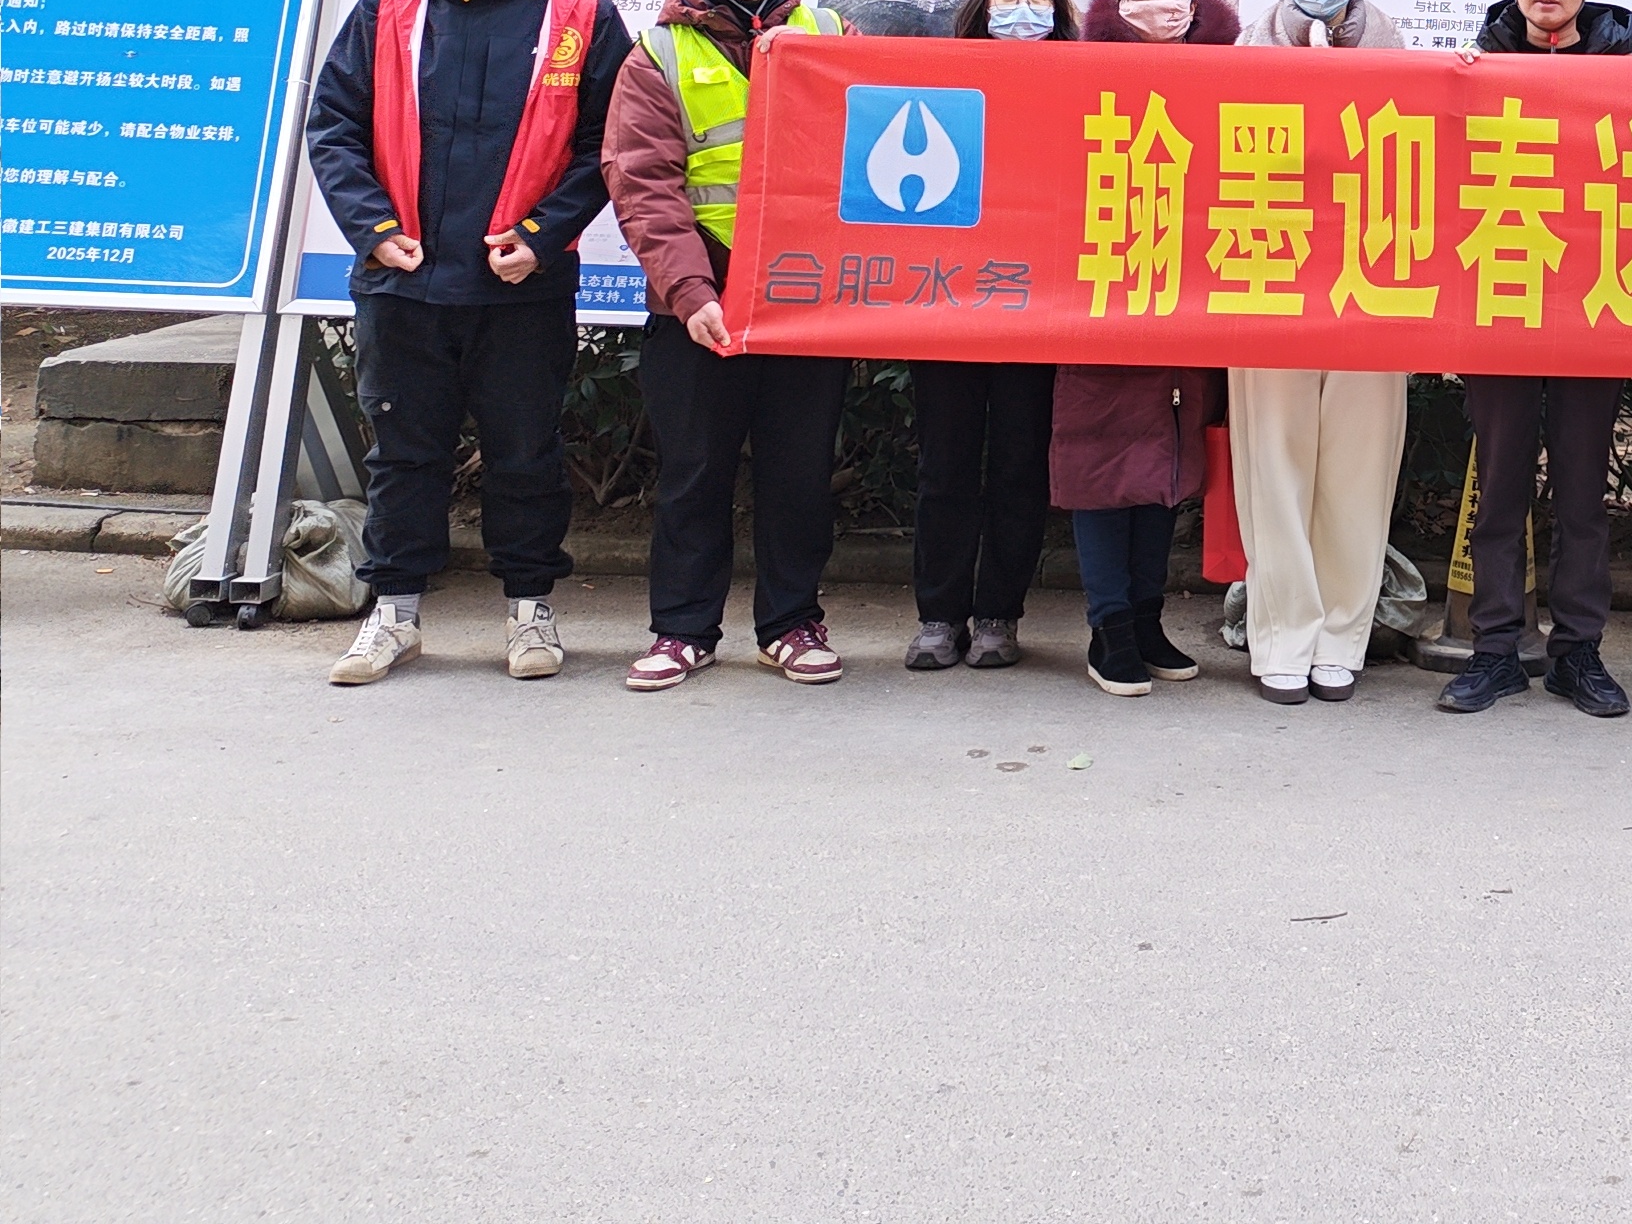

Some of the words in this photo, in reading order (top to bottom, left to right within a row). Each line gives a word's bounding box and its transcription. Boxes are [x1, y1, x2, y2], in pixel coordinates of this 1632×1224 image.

[0, 19, 250, 43] 入内，路过时请保持安全距离，照
[0, 118, 242, 142] 车位可能减少，请配合物业安排，
[0, 167, 126, 188] 您的理解与配合。
[0, 218, 185, 240] 徽建工三建集团有限公司
[46, 247, 135, 264] 2025年12月
[763, 251, 1033, 311] 合肥水务
